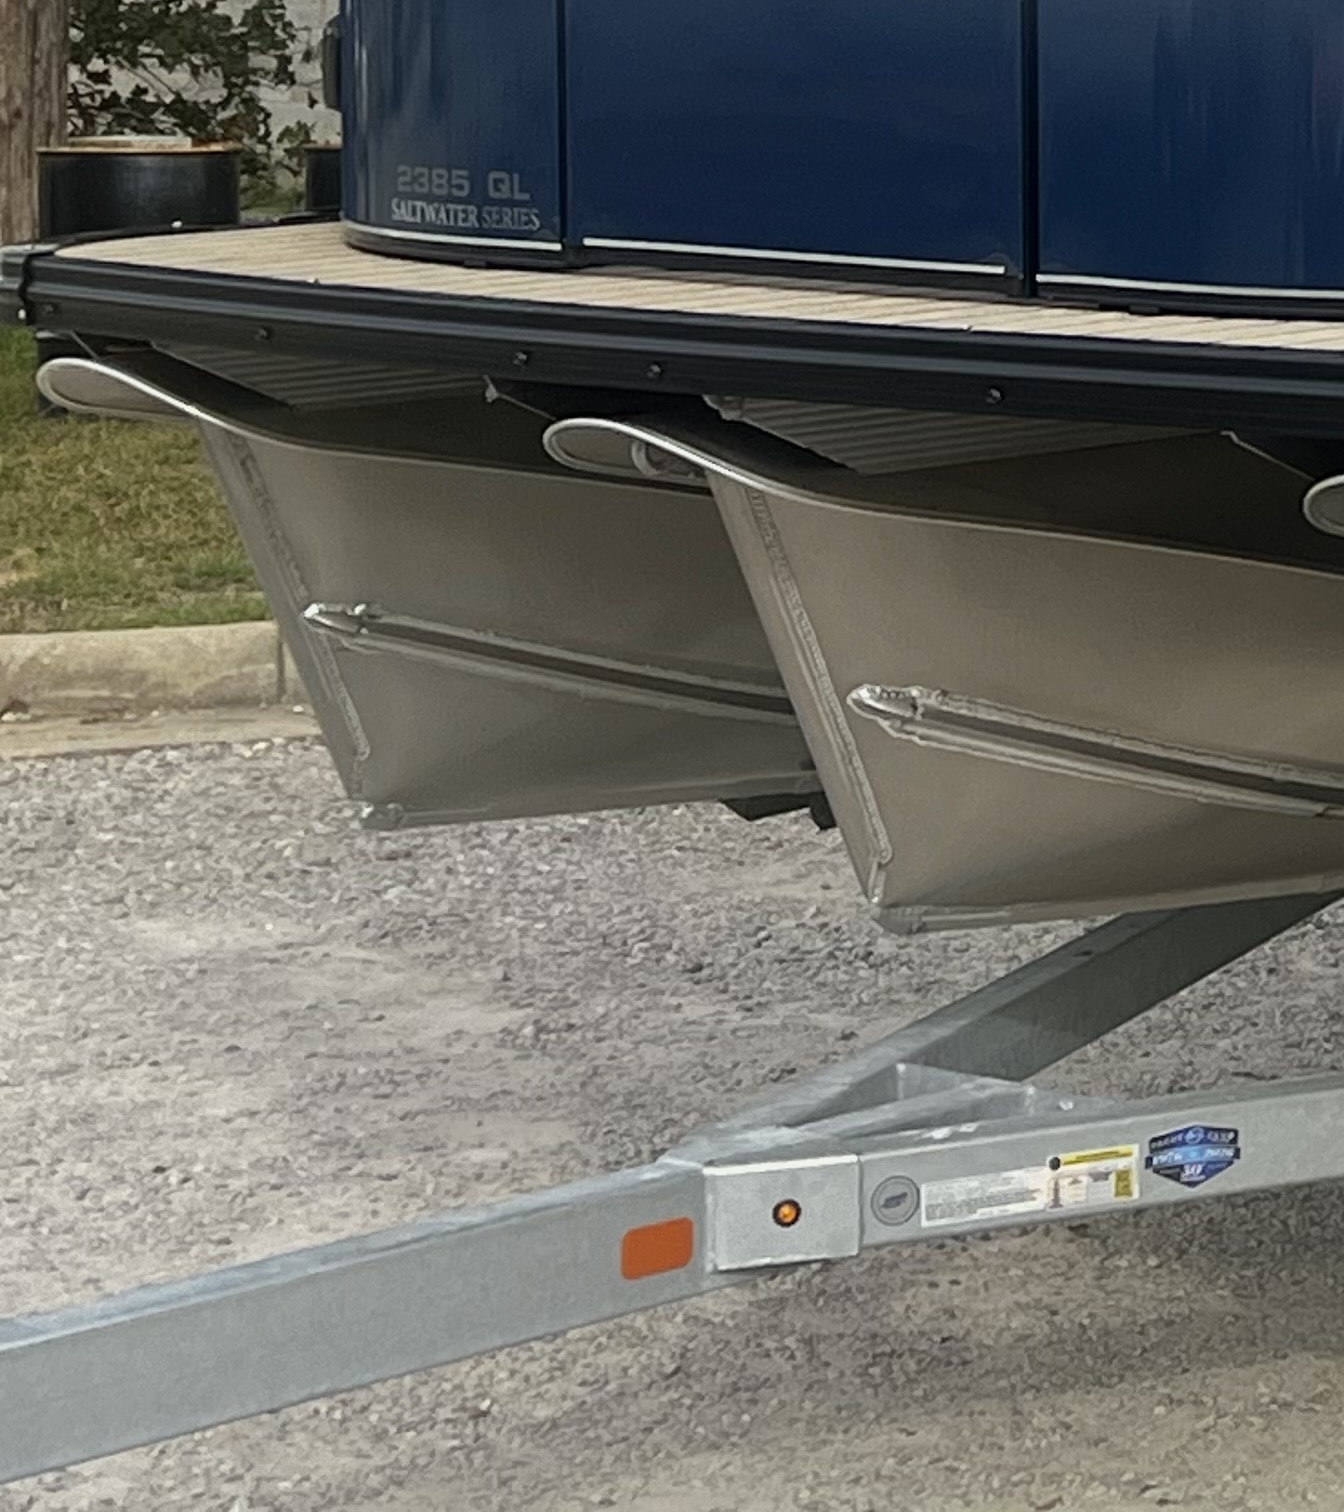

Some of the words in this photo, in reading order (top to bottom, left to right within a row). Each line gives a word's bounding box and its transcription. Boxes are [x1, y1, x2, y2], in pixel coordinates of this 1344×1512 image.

[396, 164, 471, 198] 2385
[487, 170, 531, 201] QL
[391, 197, 480, 229] SALTWATER
[481, 205, 541, 232] SERIES
